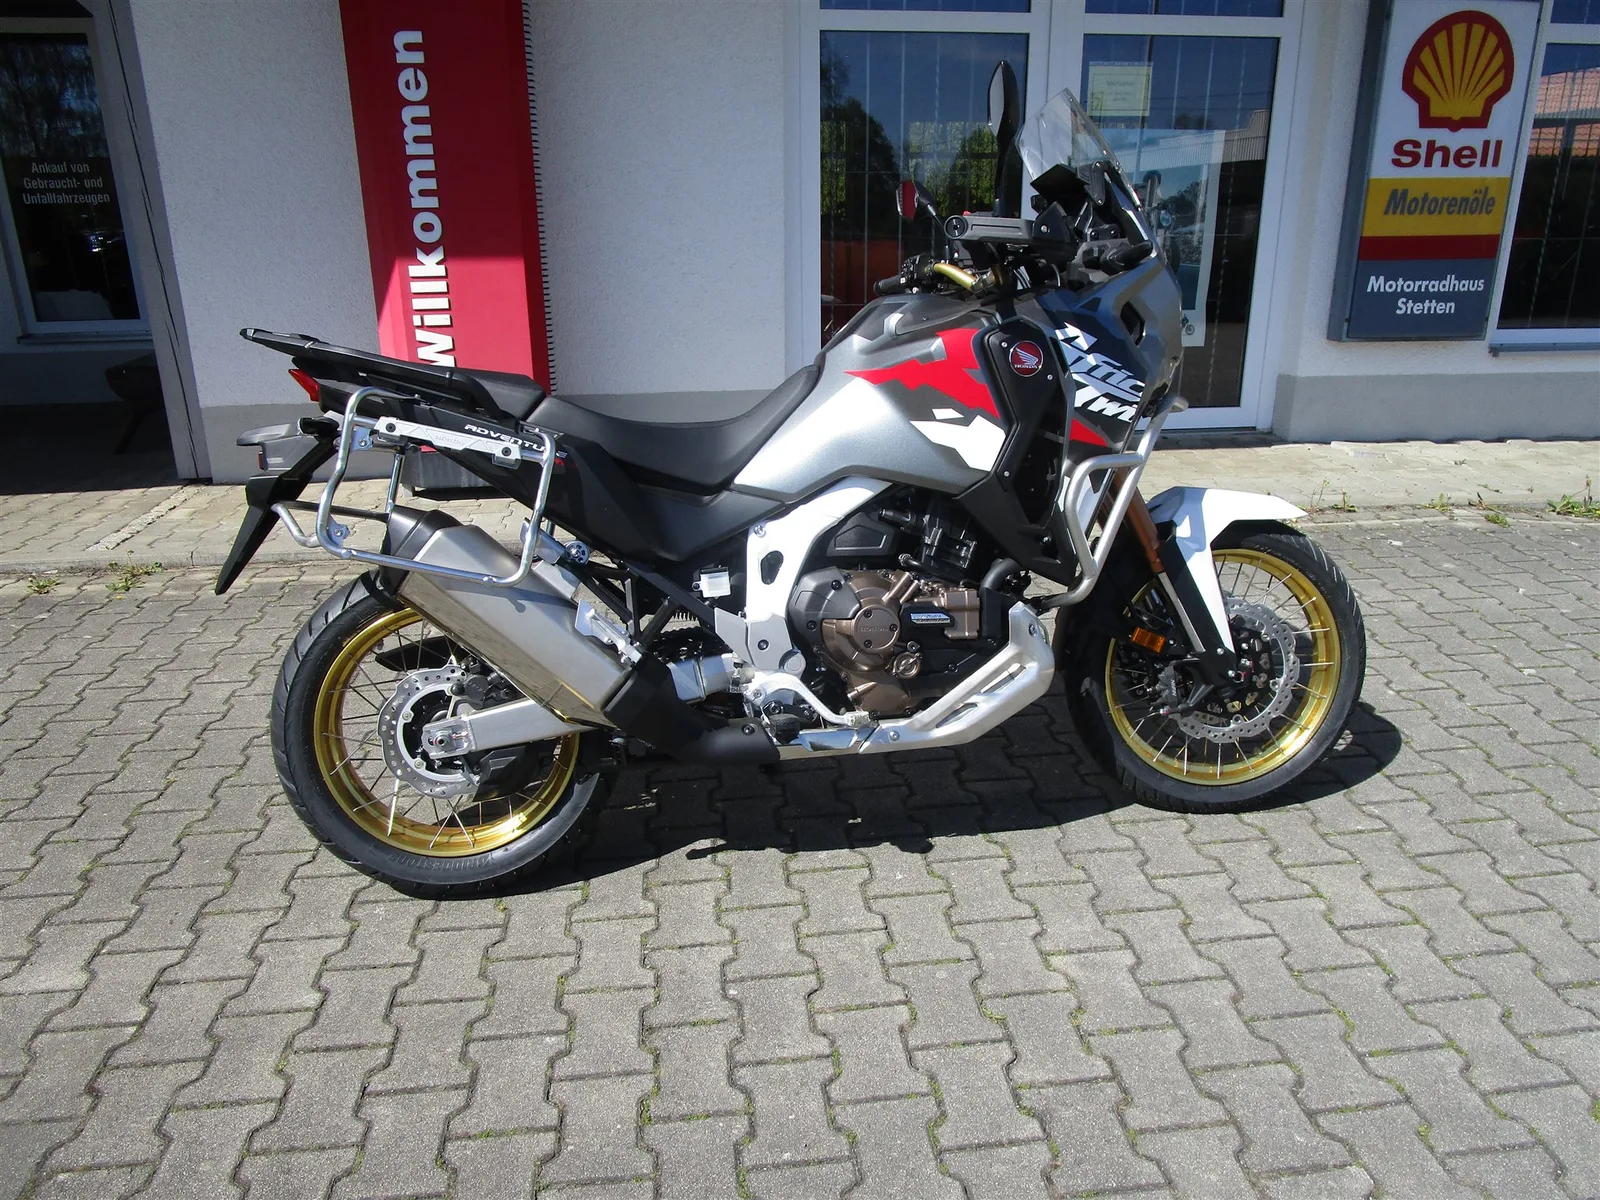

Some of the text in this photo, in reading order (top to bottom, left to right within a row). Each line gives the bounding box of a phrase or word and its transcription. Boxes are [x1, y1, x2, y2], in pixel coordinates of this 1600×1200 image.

[1391, 139, 1503, 169] Shell
[31, 161, 91, 174] Ankauf von
[23, 177, 104, 189] Gebraucht- und
[22, 192, 111, 206] Unfallfahrzeugen
[1383, 186, 1496, 216] Motorenöle
[1366, 274, 1485, 293] Motorradhaus
[1396, 297, 1456, 315] Stetten
[463, 423, 568, 460] ADVENTUE
